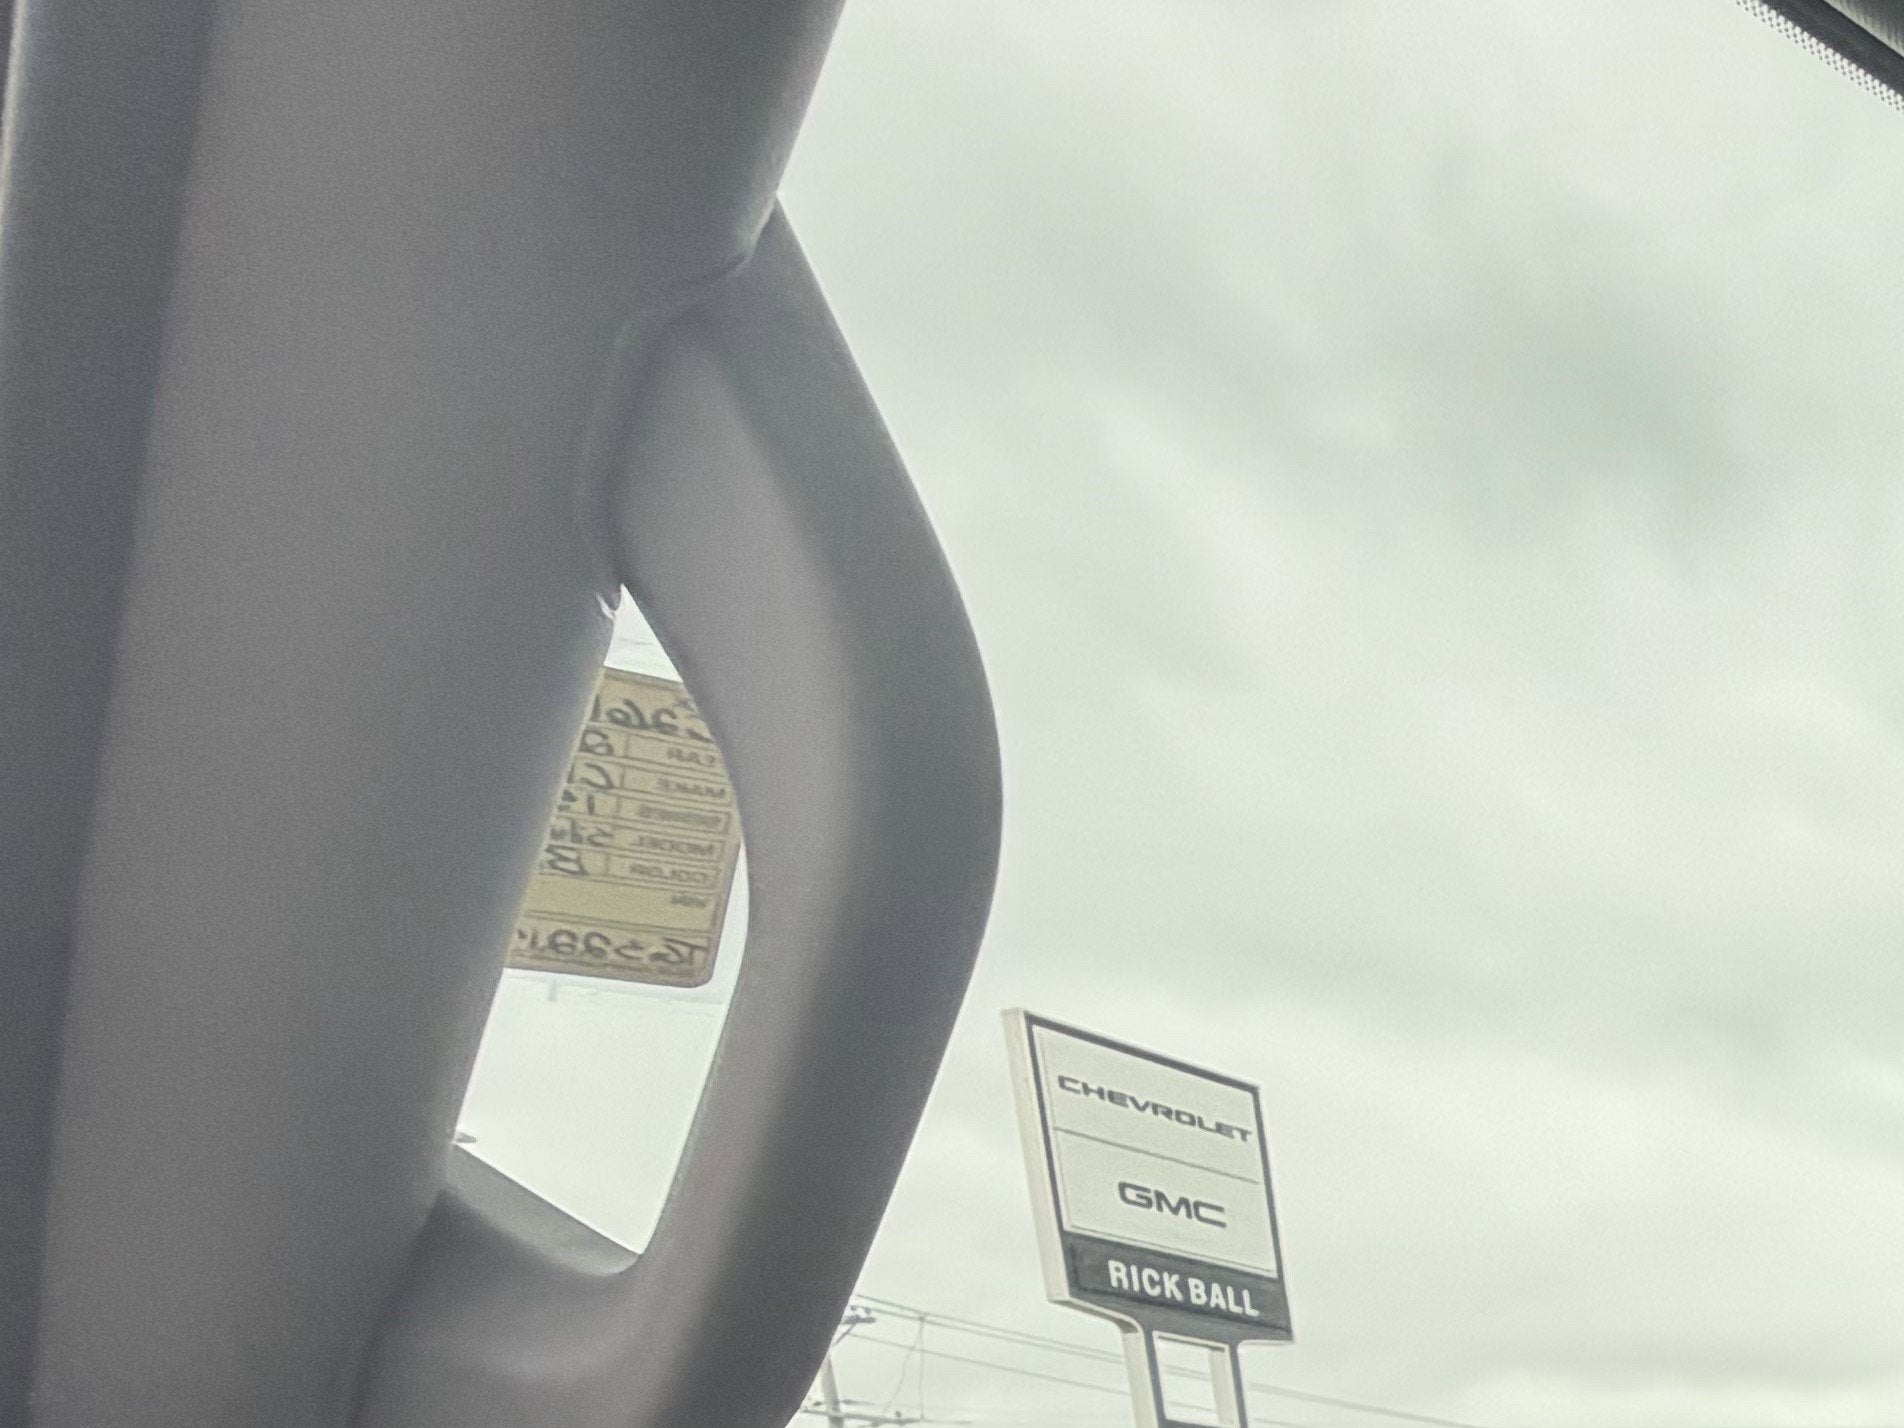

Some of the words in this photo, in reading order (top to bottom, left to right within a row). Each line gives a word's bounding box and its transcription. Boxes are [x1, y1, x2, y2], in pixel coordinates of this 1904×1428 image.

[1057, 1074, 1253, 1143] CHEVROLET
[1118, 1180, 1227, 1229] GMC
[1107, 1259, 1183, 1302] RICK
[1188, 1278, 1261, 1317] BALL
